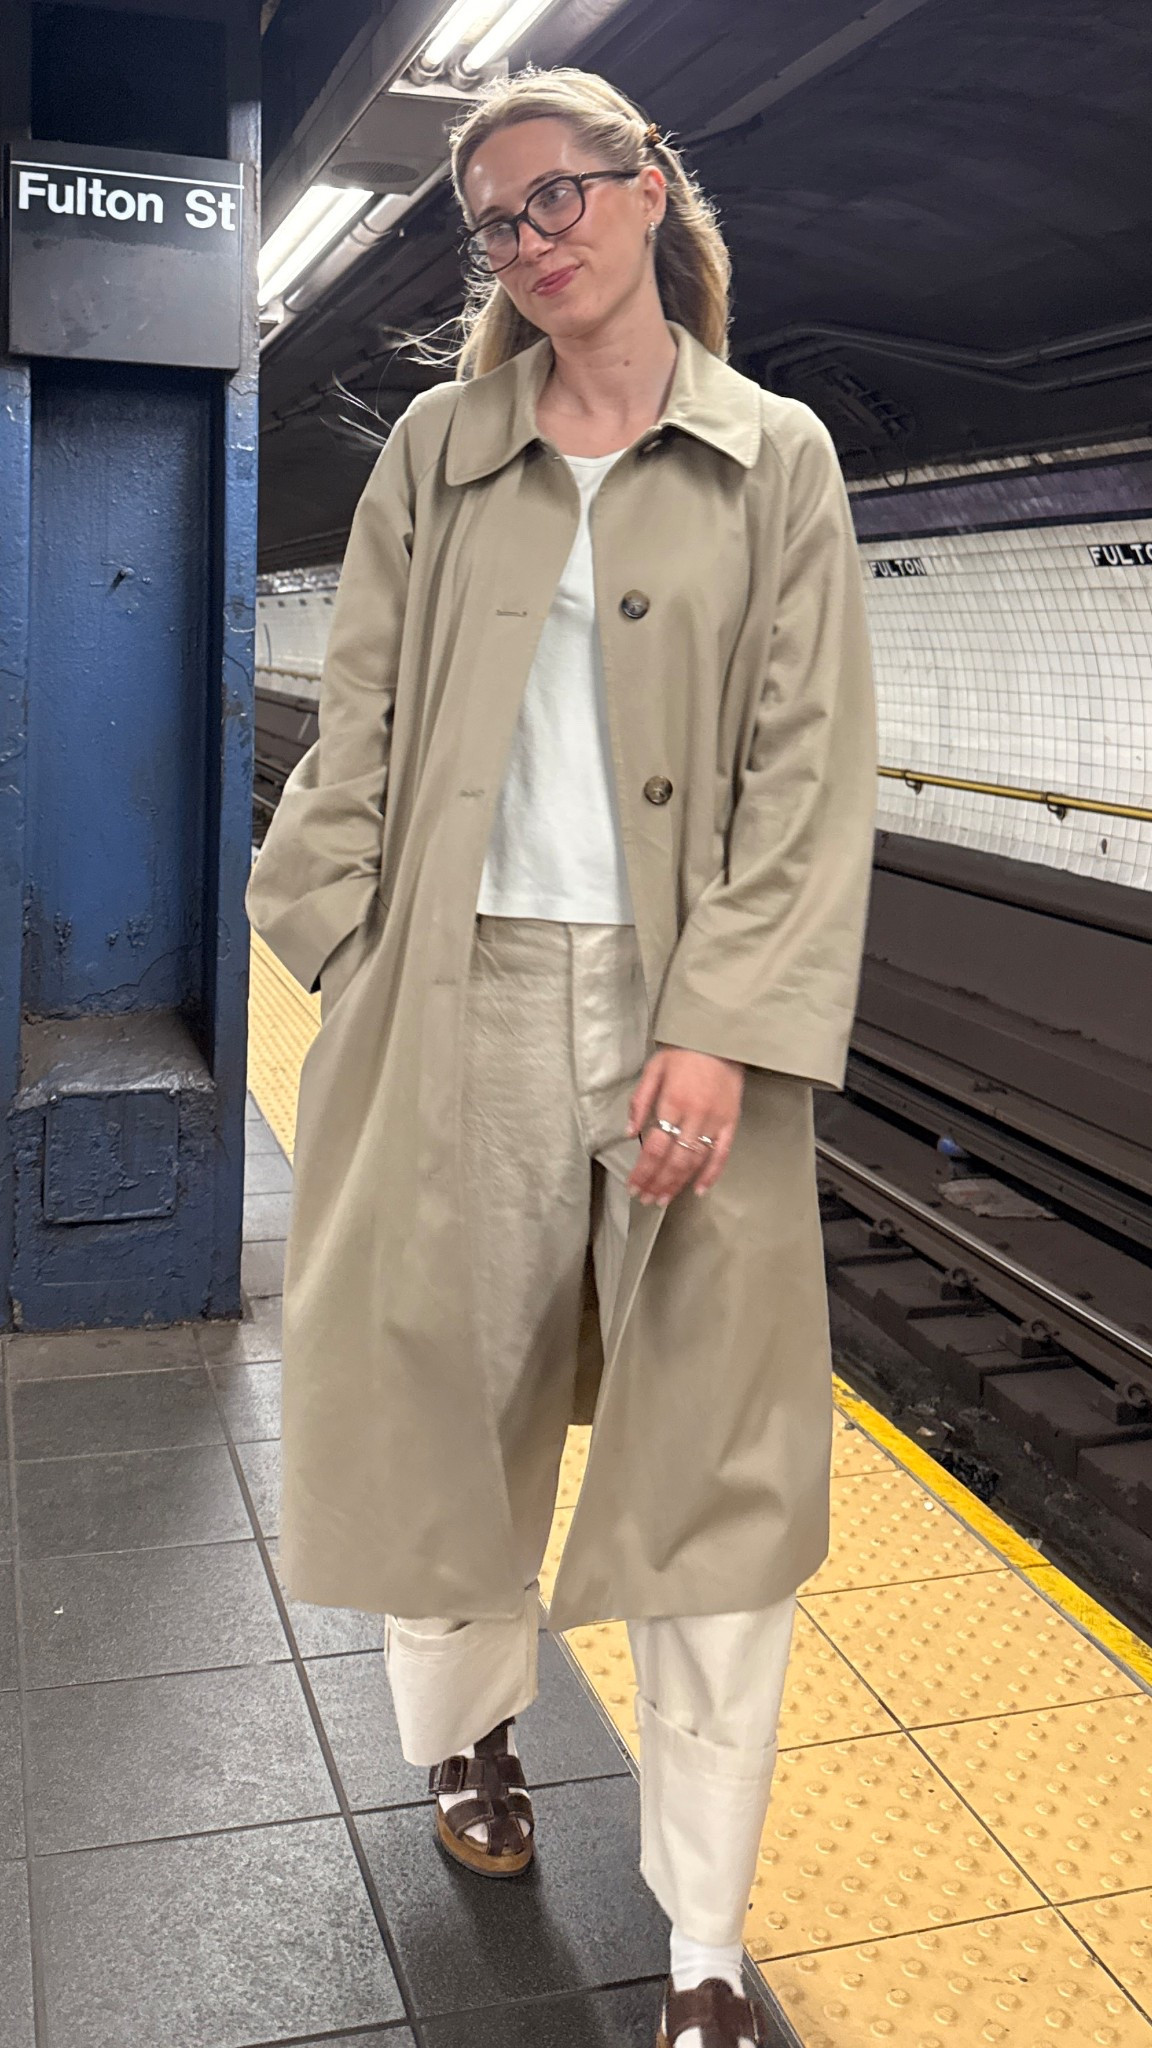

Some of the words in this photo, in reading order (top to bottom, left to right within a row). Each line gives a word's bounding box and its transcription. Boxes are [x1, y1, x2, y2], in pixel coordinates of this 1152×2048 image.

[18, 170, 164, 224] Fulton
[185, 188, 236, 231] St
[869, 558, 926, 577] FULTON
